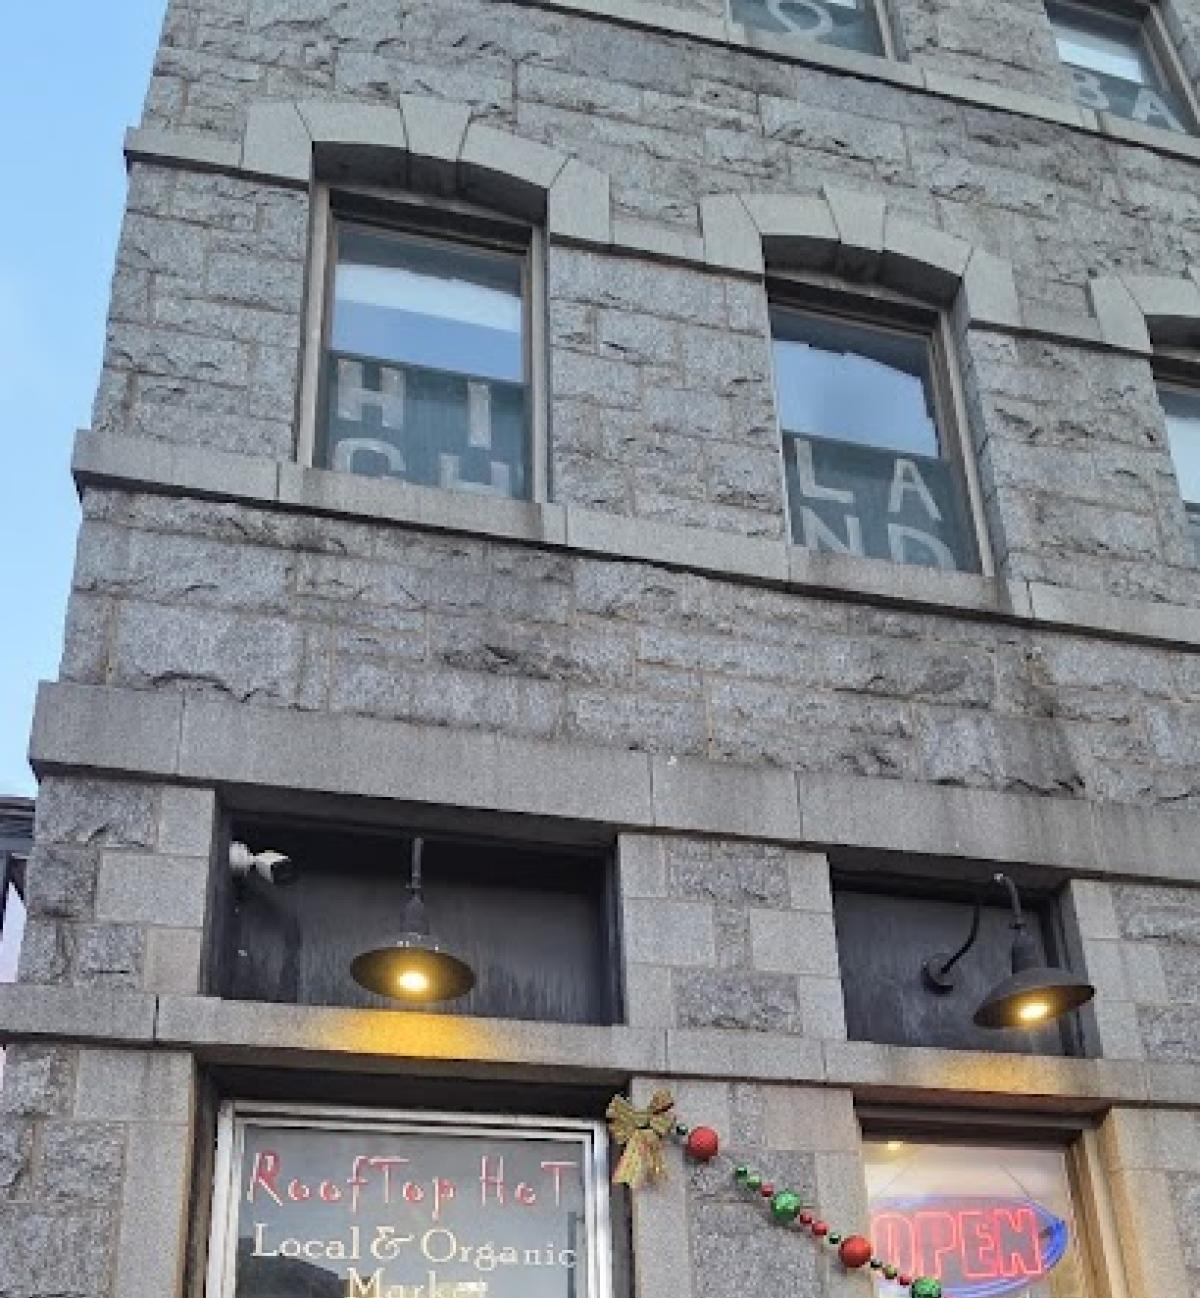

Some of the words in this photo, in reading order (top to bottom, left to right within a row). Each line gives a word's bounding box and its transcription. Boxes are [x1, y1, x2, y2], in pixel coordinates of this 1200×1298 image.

[794, 437, 941, 522] LA
[247, 1150, 458, 1223] RoofTop
[252, 1222, 361, 1261] Local
[370, 1225, 415, 1261] &
[421, 1227, 577, 1271] Organic
[871, 1207, 1042, 1278] OPEN
